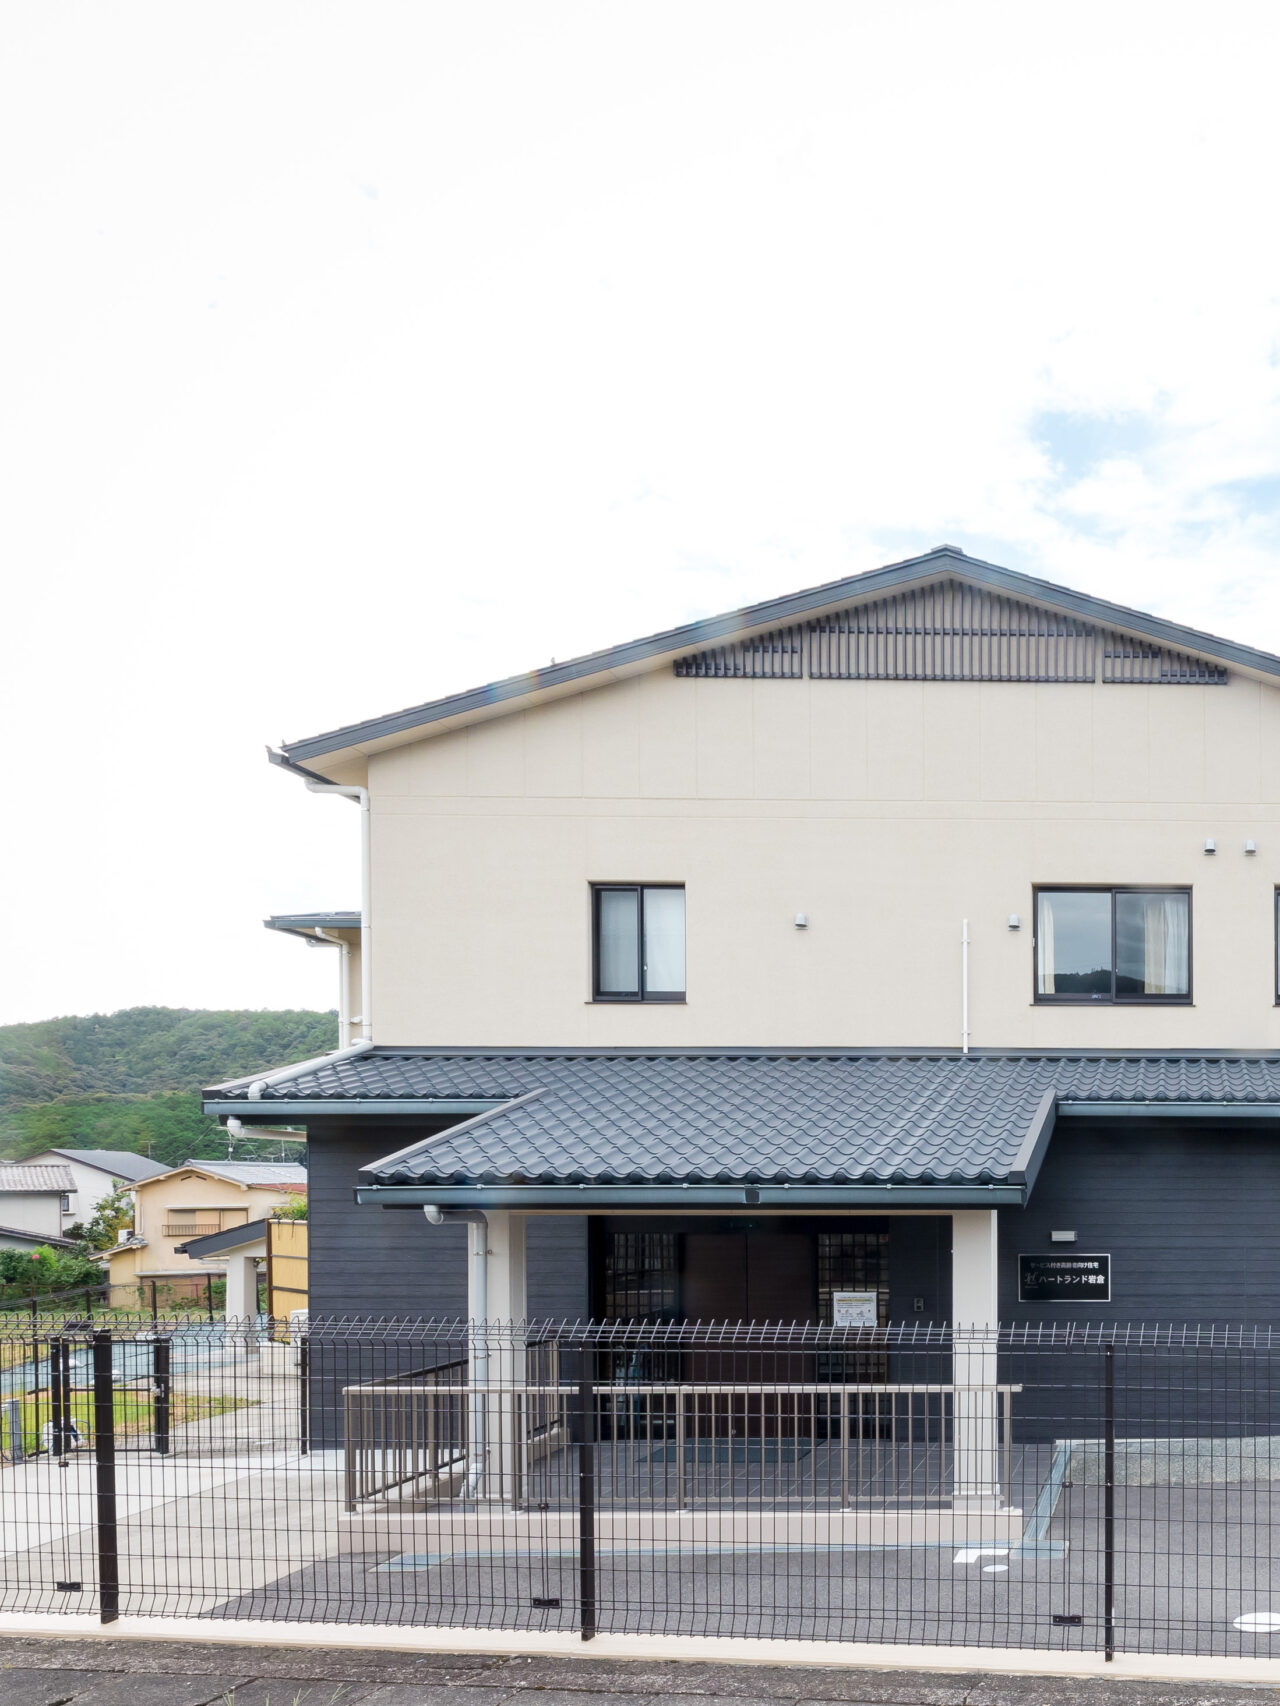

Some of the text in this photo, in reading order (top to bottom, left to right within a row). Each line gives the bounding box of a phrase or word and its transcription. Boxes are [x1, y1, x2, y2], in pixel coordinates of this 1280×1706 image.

[1039, 1274, 1105, 1284] ハートランド岩倉
